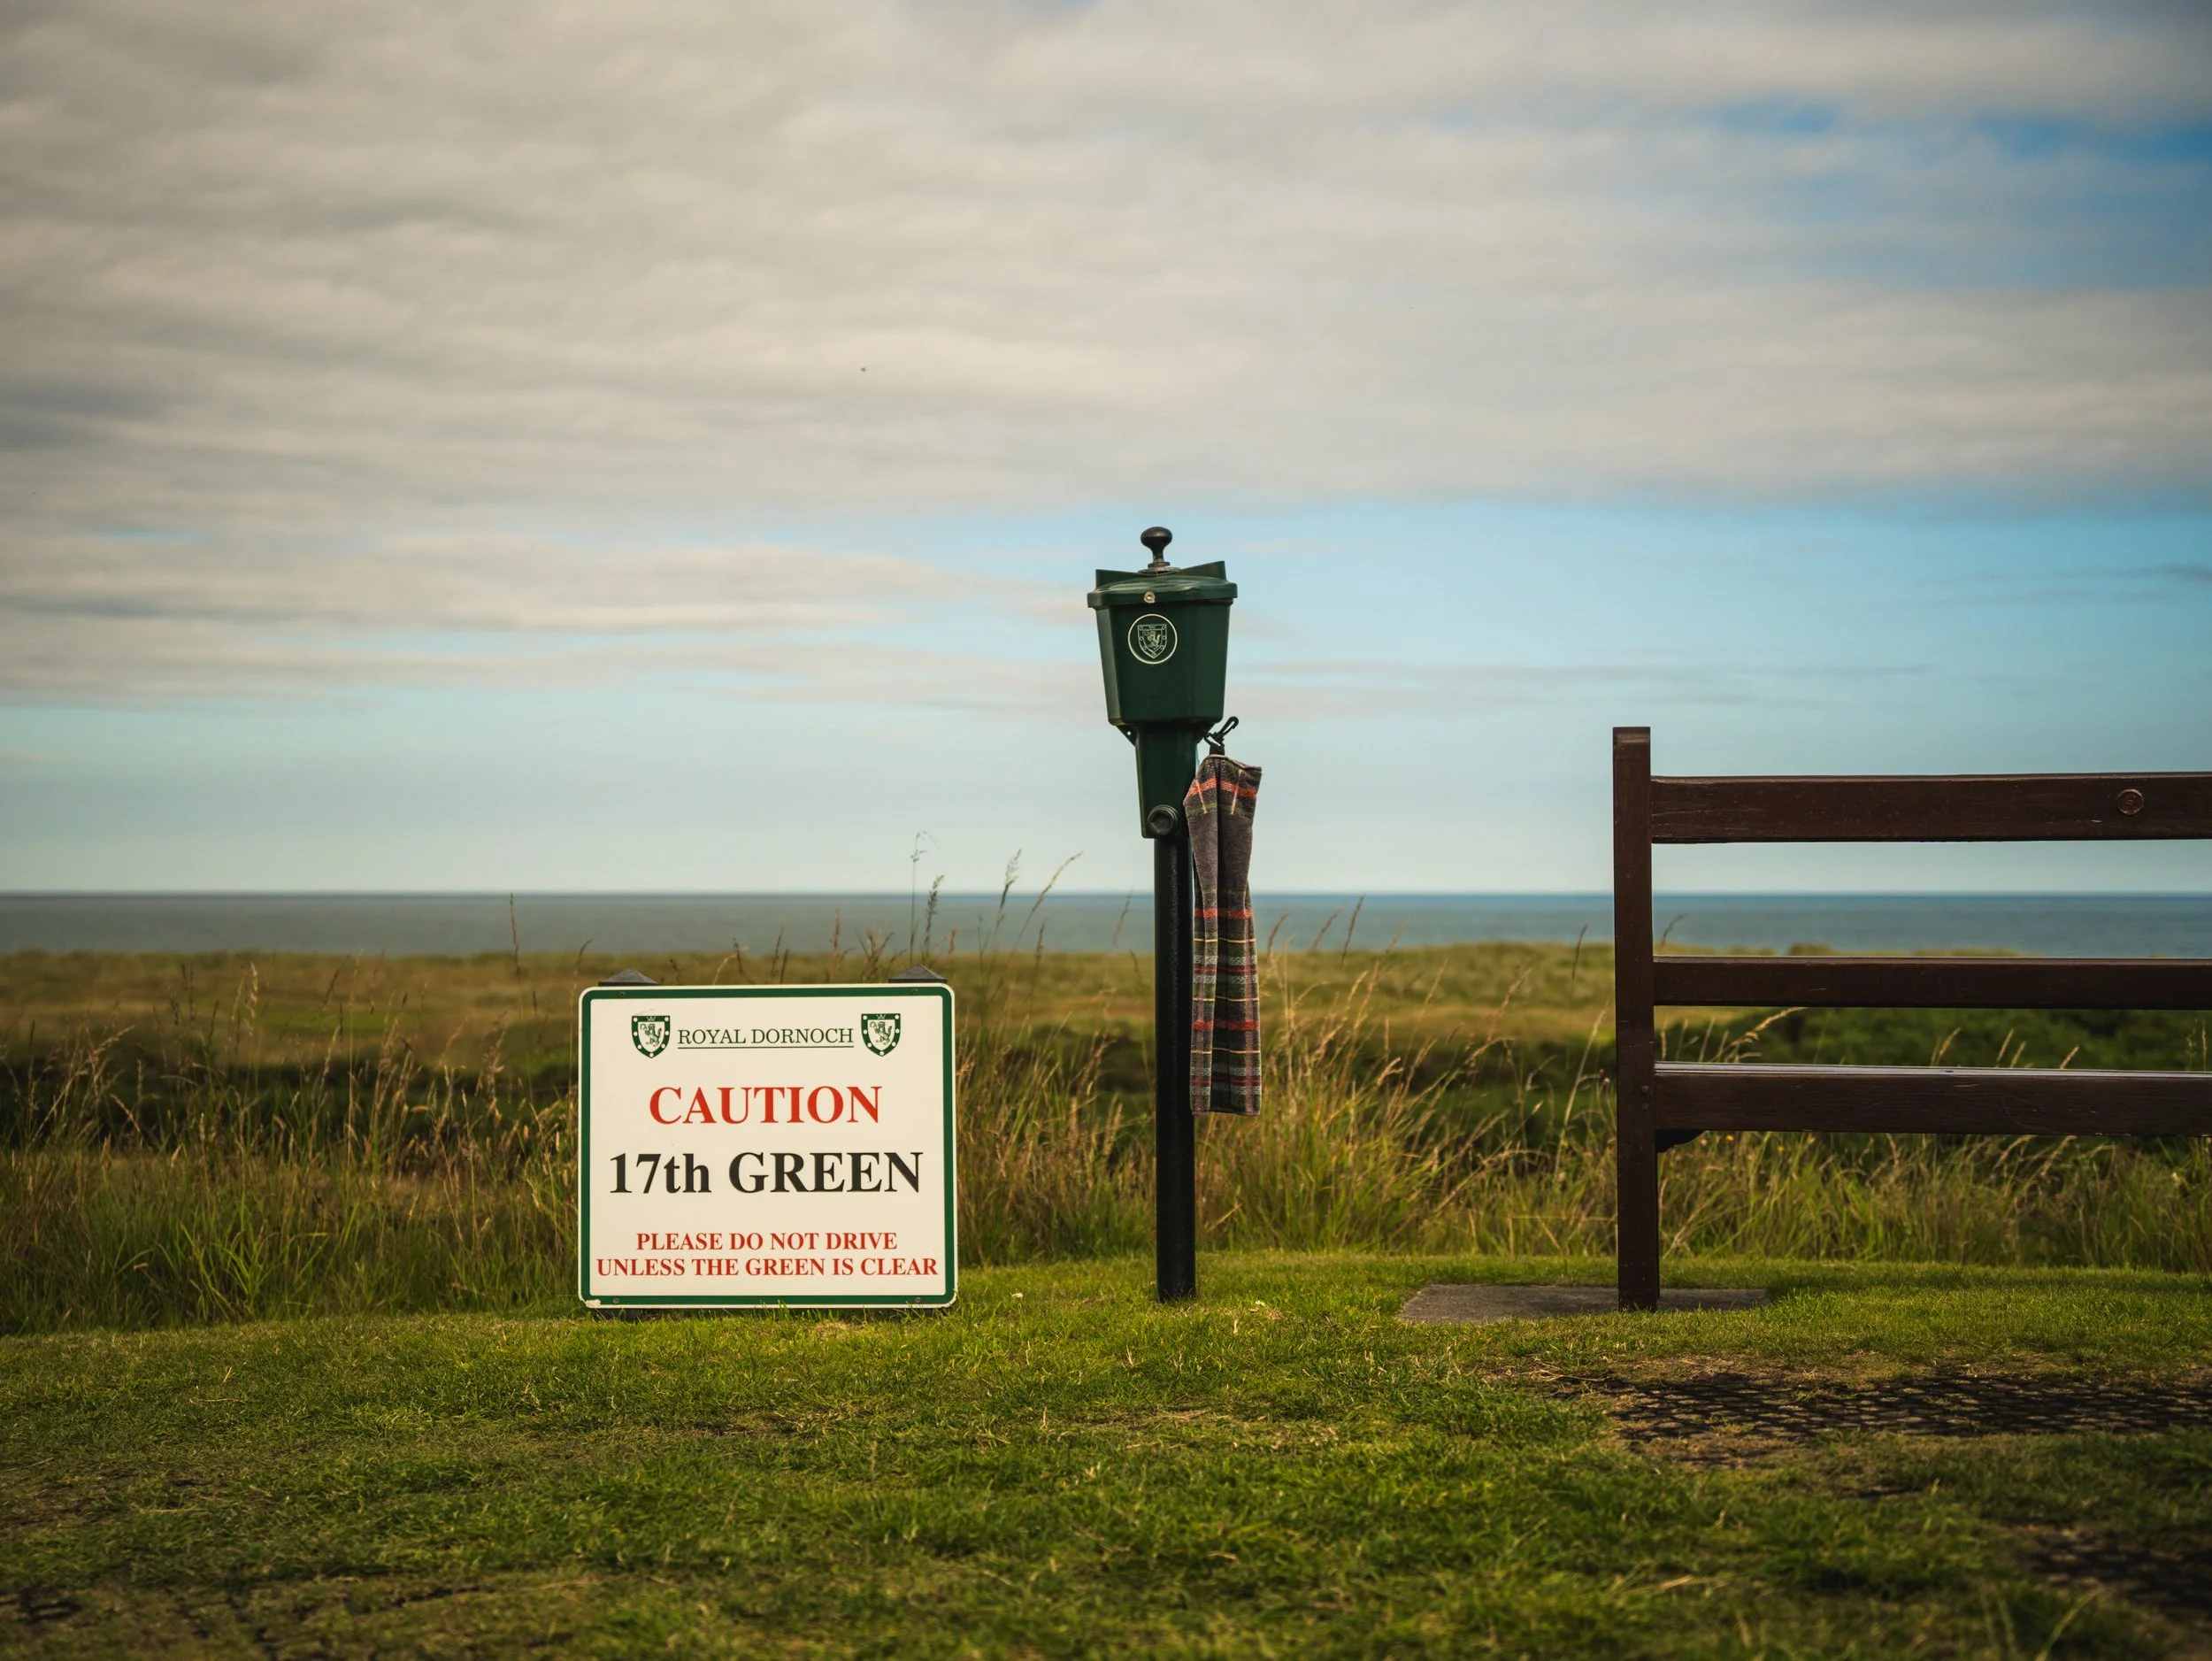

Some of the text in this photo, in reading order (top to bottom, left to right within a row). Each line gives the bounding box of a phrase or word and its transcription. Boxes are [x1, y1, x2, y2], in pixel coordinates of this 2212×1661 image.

[678, 1028, 853, 1044] ROYAL DORNOCH
[649, 1086, 882, 1124] CAUTION
[611, 1152, 923, 1194] 17th GREEN
[637, 1233, 897, 1250] PLEASE DO NOT DRIVE
[597, 1258, 938, 1276] UNLESS THE GREEN IS CLEAR
